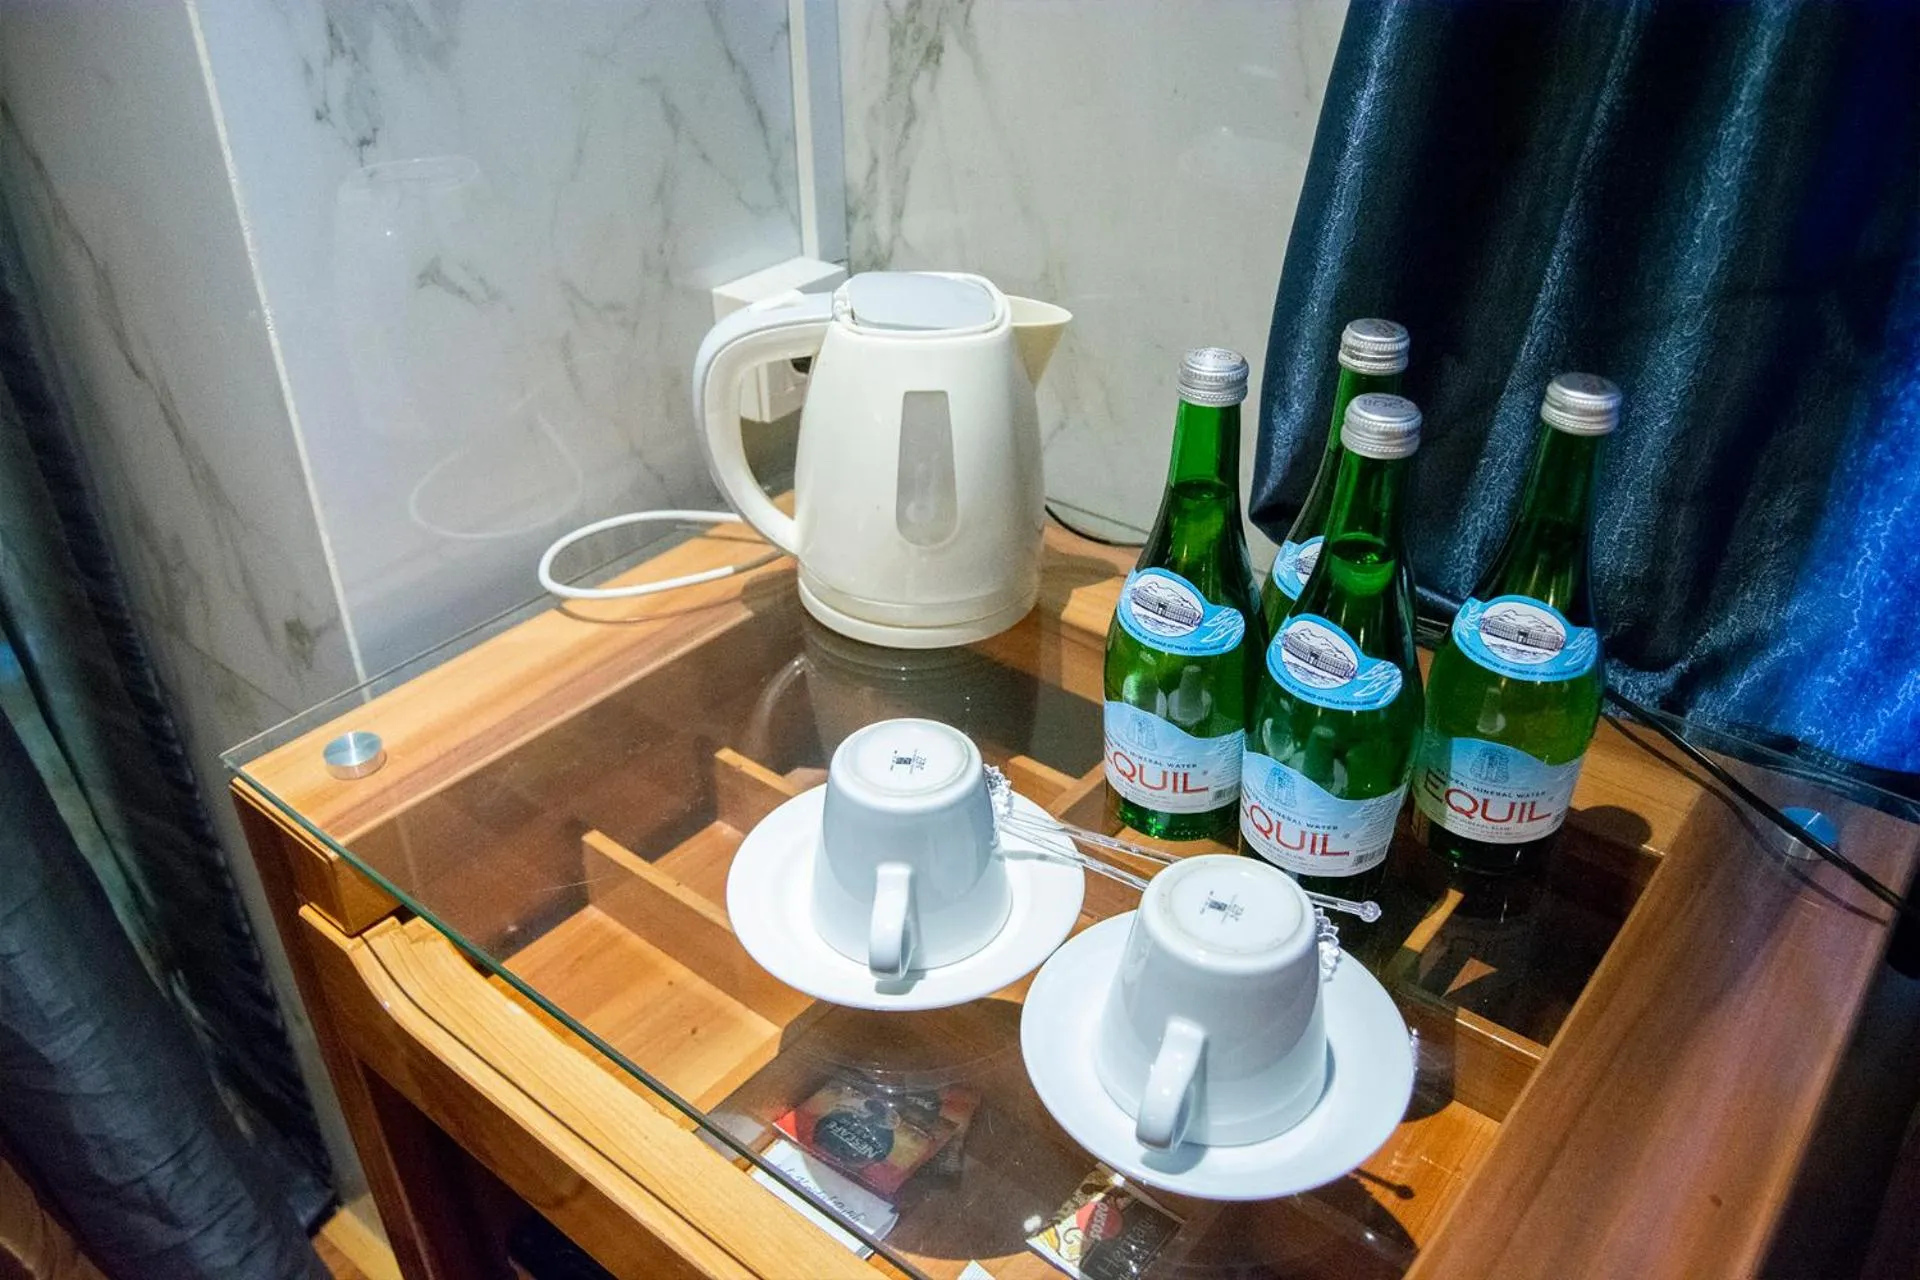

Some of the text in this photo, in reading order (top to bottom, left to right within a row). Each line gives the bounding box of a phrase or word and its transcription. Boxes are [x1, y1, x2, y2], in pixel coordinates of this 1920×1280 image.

[1424, 767, 1551, 824] EQUIL
[1472, 786, 1514, 799] MINERAL
[1516, 790, 1546, 799] WATER
[1306, 822, 1339, 831] WATER
[1089, 1201, 1109, 1240] SOSRO
